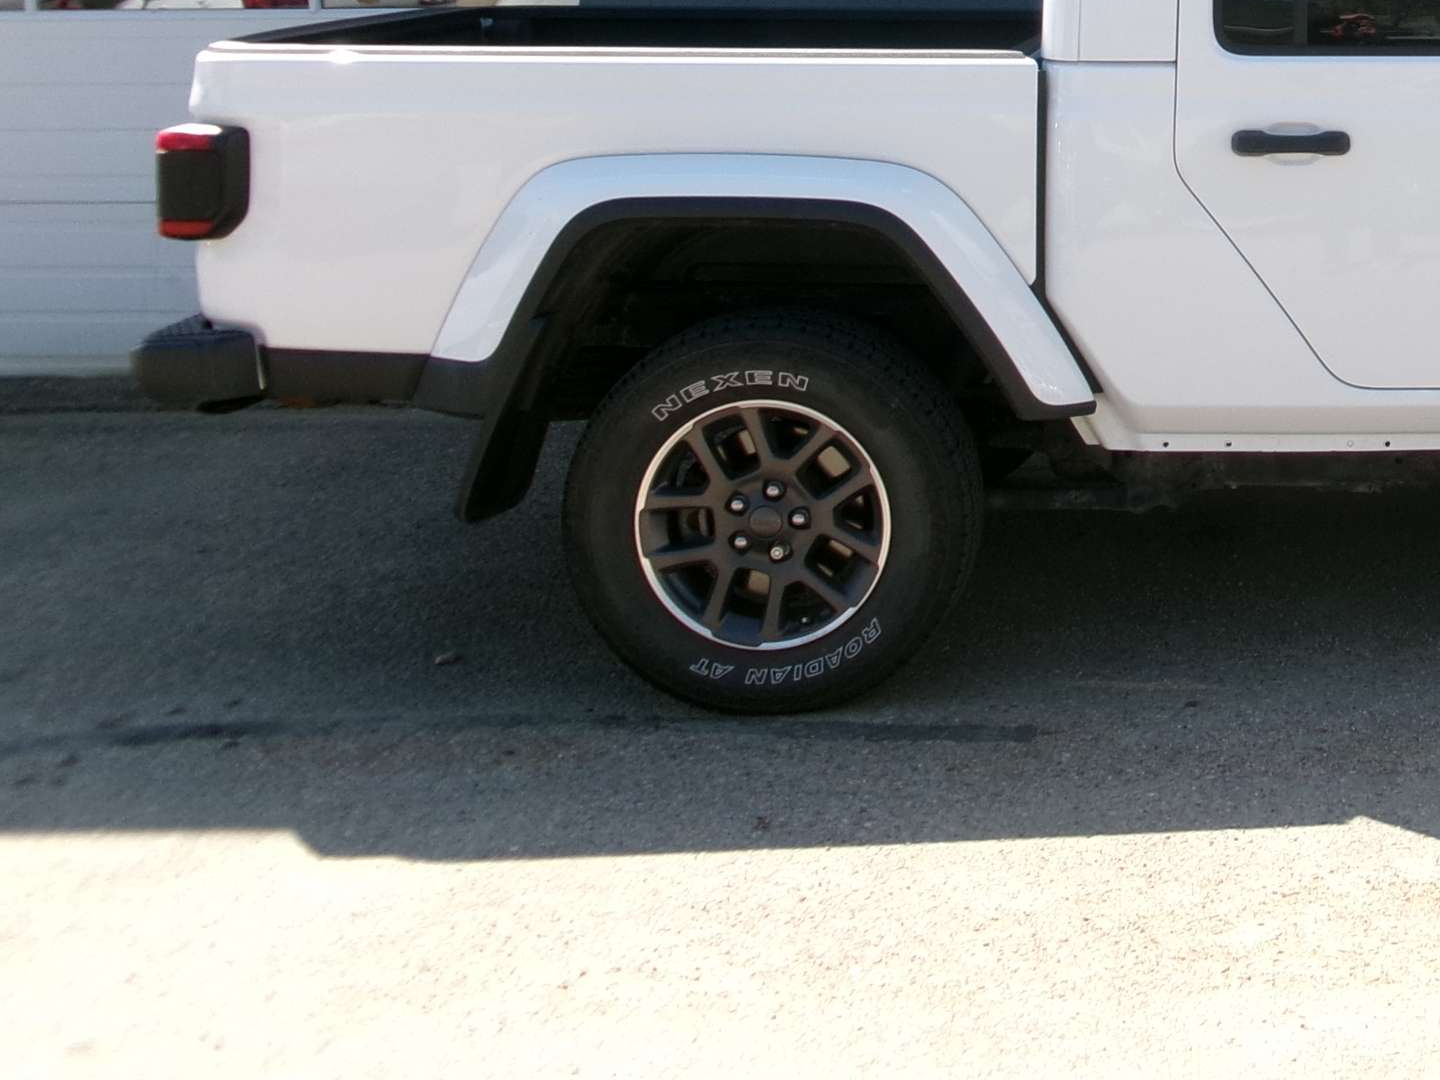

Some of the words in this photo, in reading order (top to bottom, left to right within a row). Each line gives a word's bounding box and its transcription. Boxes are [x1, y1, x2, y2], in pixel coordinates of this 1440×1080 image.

[651, 369, 808, 422] NEXEN
[690, 657, 735, 680] AT
[744, 617, 883, 686] ROADIAN
